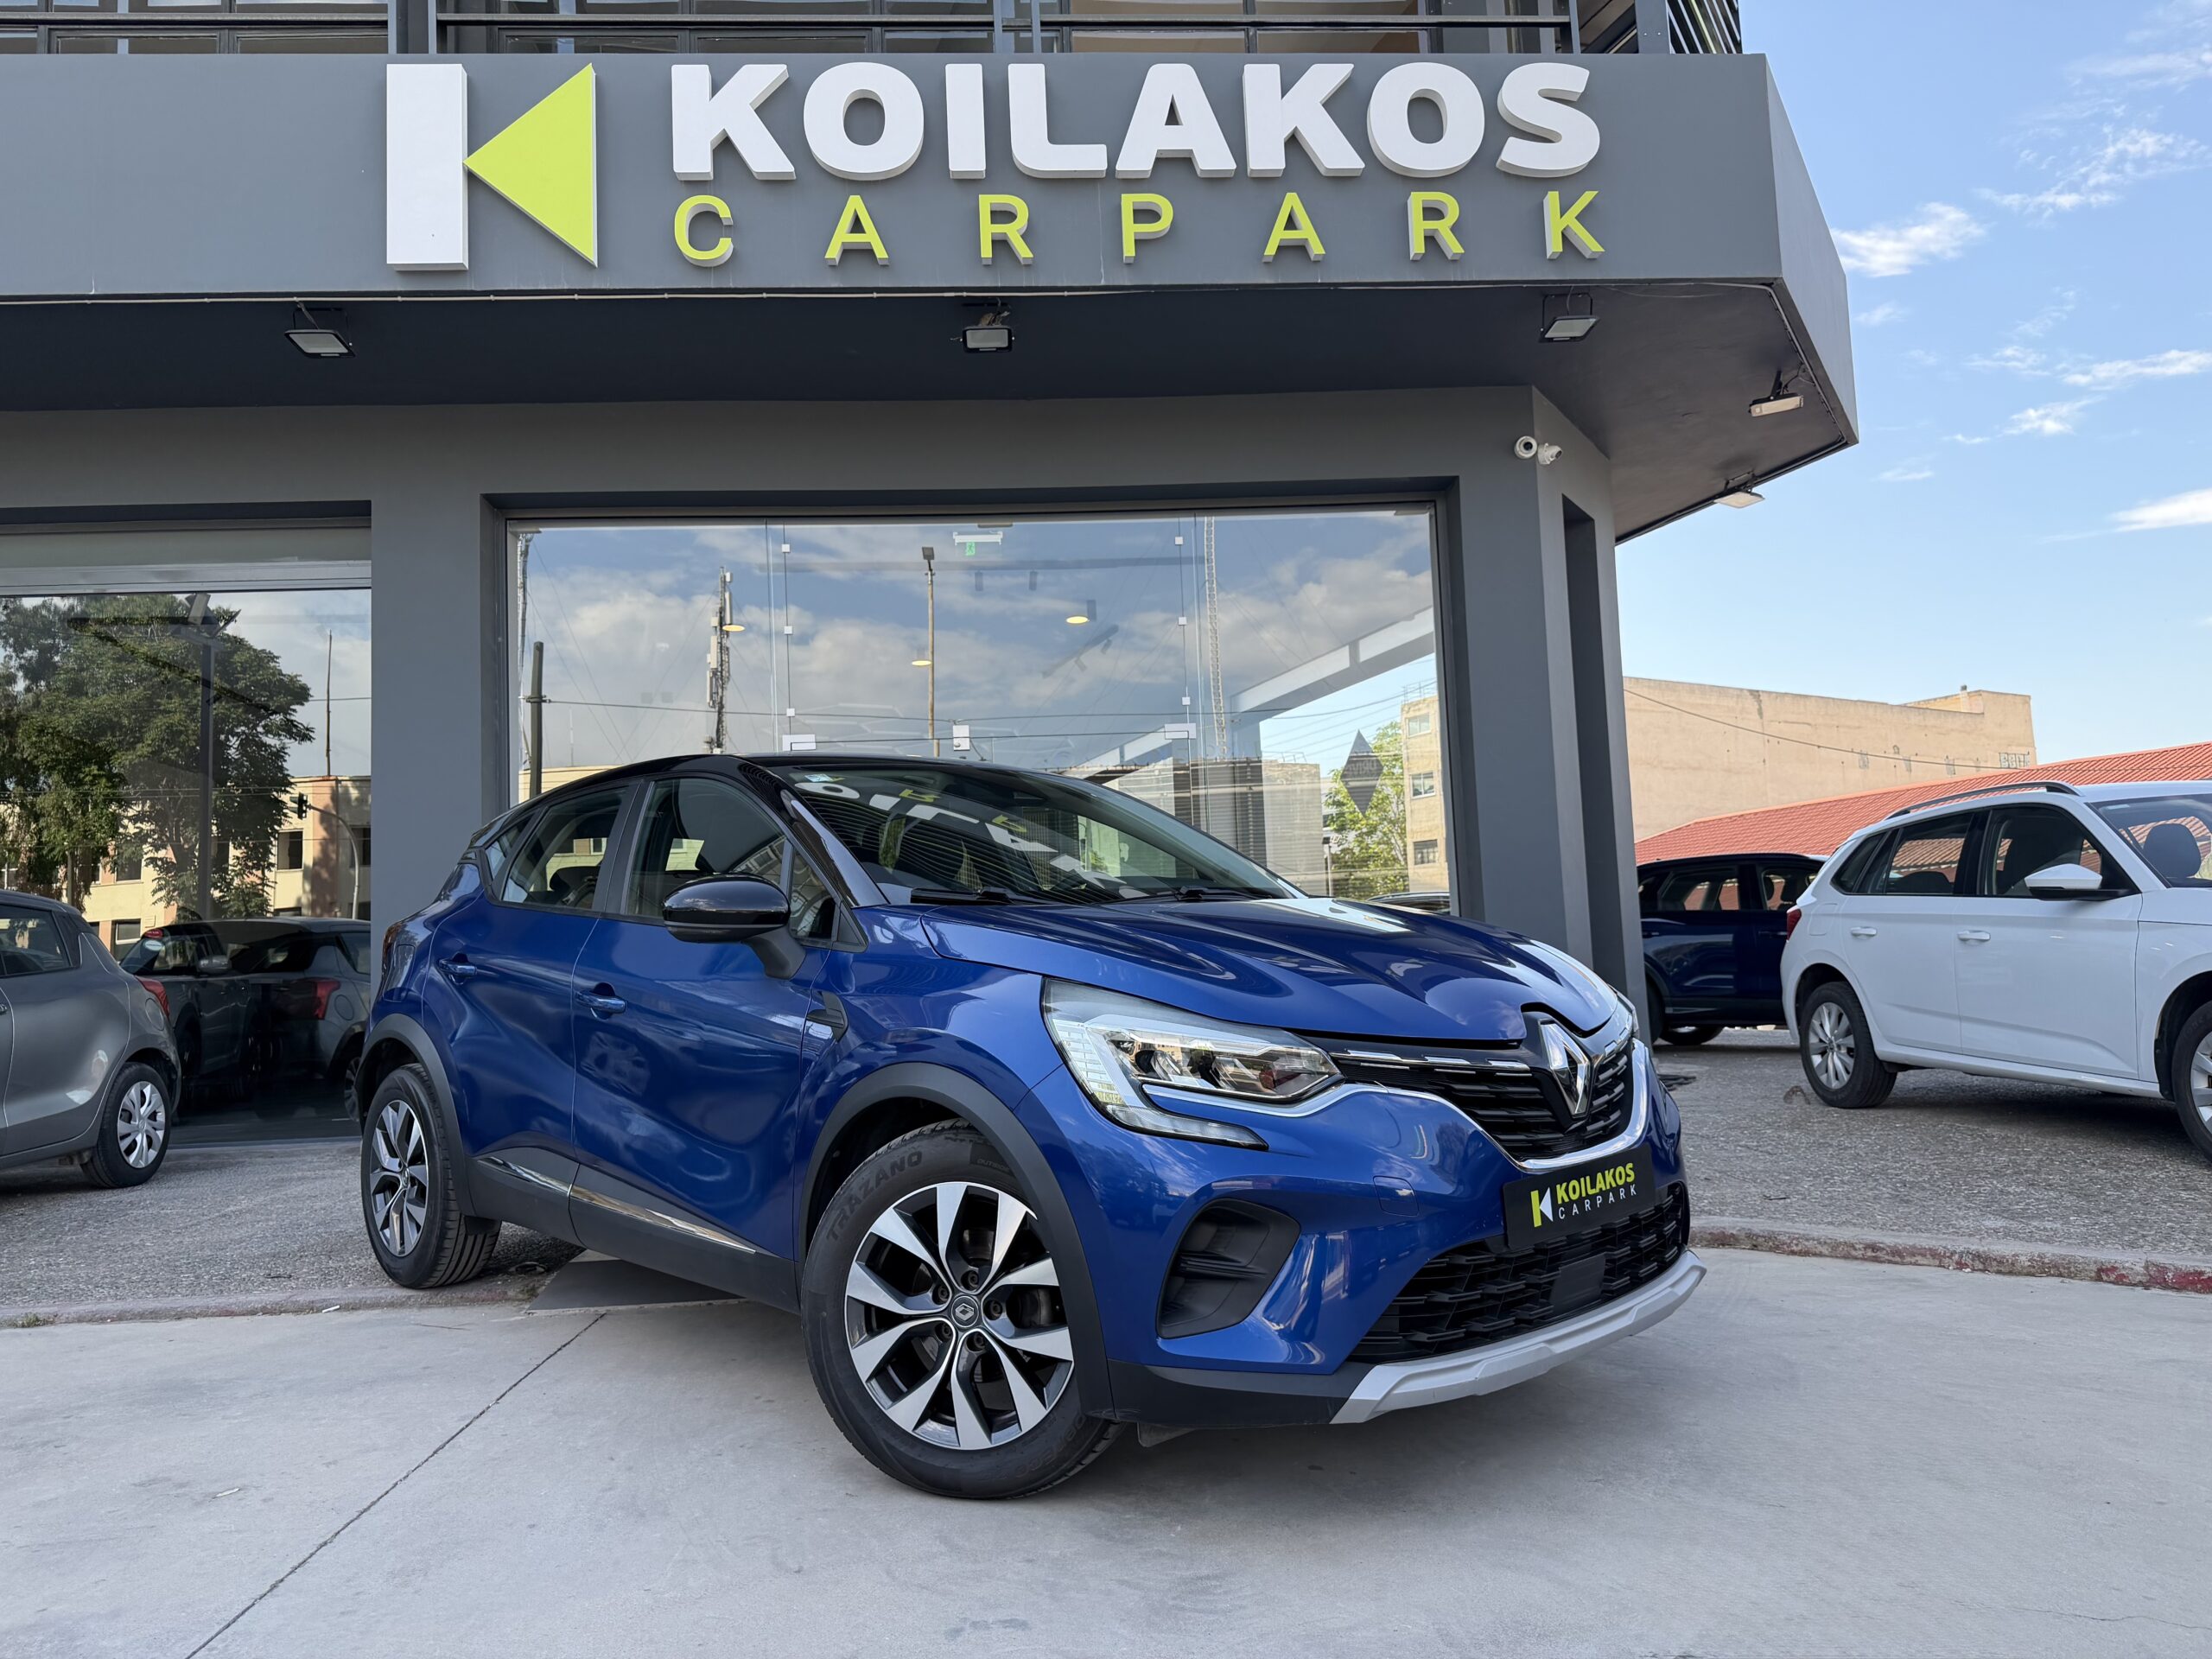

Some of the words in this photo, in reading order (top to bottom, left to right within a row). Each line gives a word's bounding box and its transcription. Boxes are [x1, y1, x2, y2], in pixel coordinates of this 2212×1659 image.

[671, 61, 1600, 180] KOILAKOS
[674, 191, 1605, 267] CARPARK
[826, 1150, 923, 1241] TRAZANO
[1555, 1162, 1636, 1205] KOILAKOS
[1558, 1183, 1637, 1220] CARPARK
